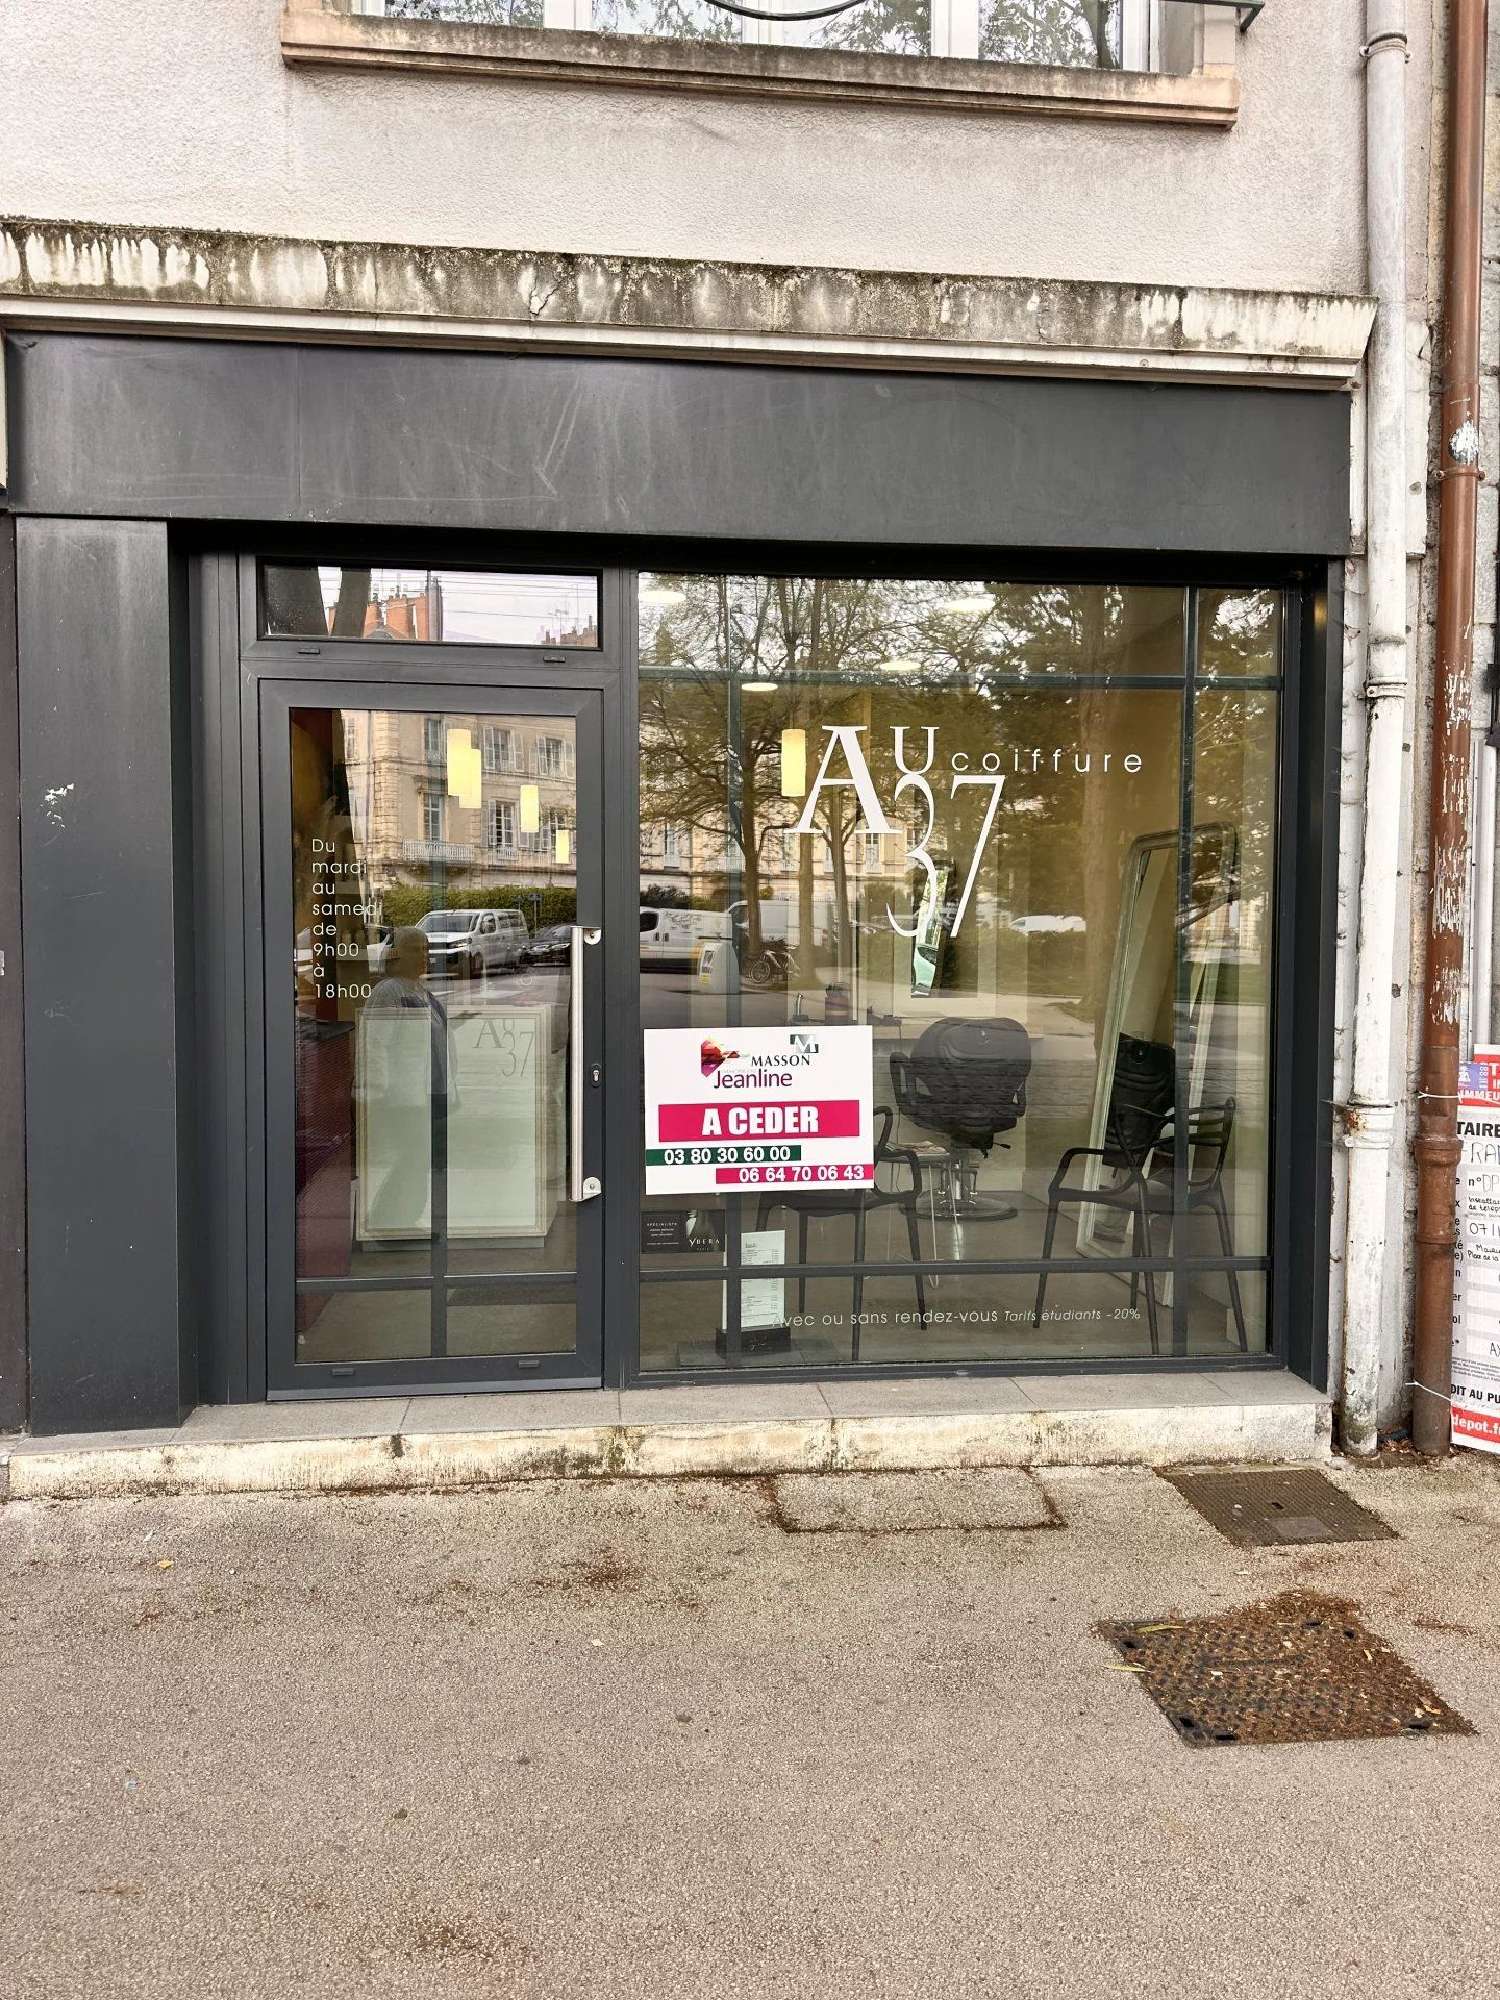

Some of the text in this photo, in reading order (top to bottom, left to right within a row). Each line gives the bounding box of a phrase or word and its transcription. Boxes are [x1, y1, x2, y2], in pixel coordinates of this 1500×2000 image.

[952, 749, 1142, 773] coiffure
[312, 839, 335, 852] Du
[886, 773, 1006, 938] 37
[312, 859, 367, 874] mardi
[312, 882, 335, 895] au
[313, 922, 337, 936] de
[313, 943, 359, 956] 9h00
[313, 962, 325, 977] à
[315, 983, 372, 998] 18h00
[751, 1055, 811, 1067] MASSON
[714, 1069, 793, 1089] Jeanline
[702, 1105, 819, 1136] A CEDER
[664, 1146, 791, 1164] 03 80 30 60 00
[739, 1165, 865, 1182] 06 64 70 06 43
[822, 1314, 843, 1326] ou
[850, 1311, 888, 1325] sans
[895, 1308, 998, 1323] rendez-vous
[1469, 1388, 1483, 1400] AU
